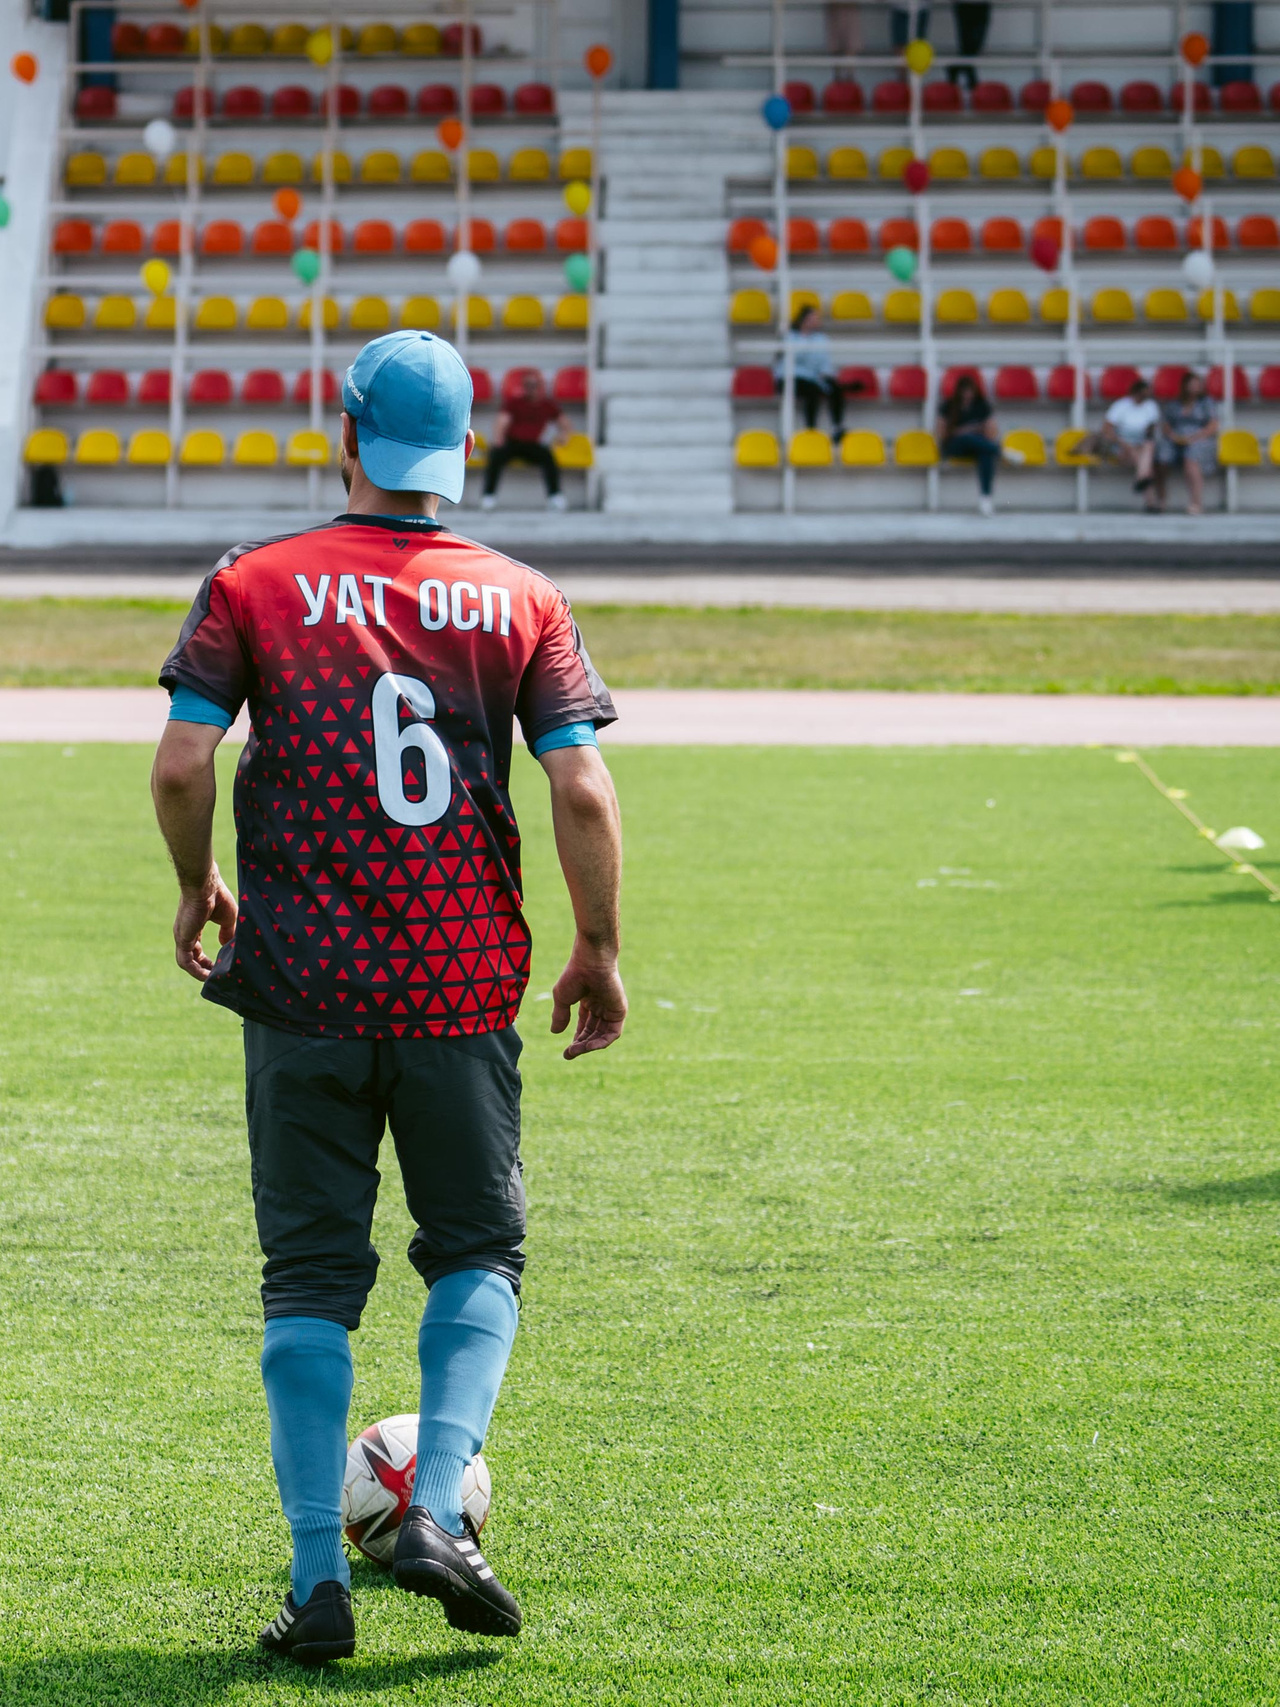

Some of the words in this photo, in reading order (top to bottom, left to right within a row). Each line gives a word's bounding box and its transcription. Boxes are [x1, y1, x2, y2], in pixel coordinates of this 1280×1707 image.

[294, 573, 393, 627] УАТ
[418, 577, 511, 638] ОСП
[371, 671, 452, 827] 6
